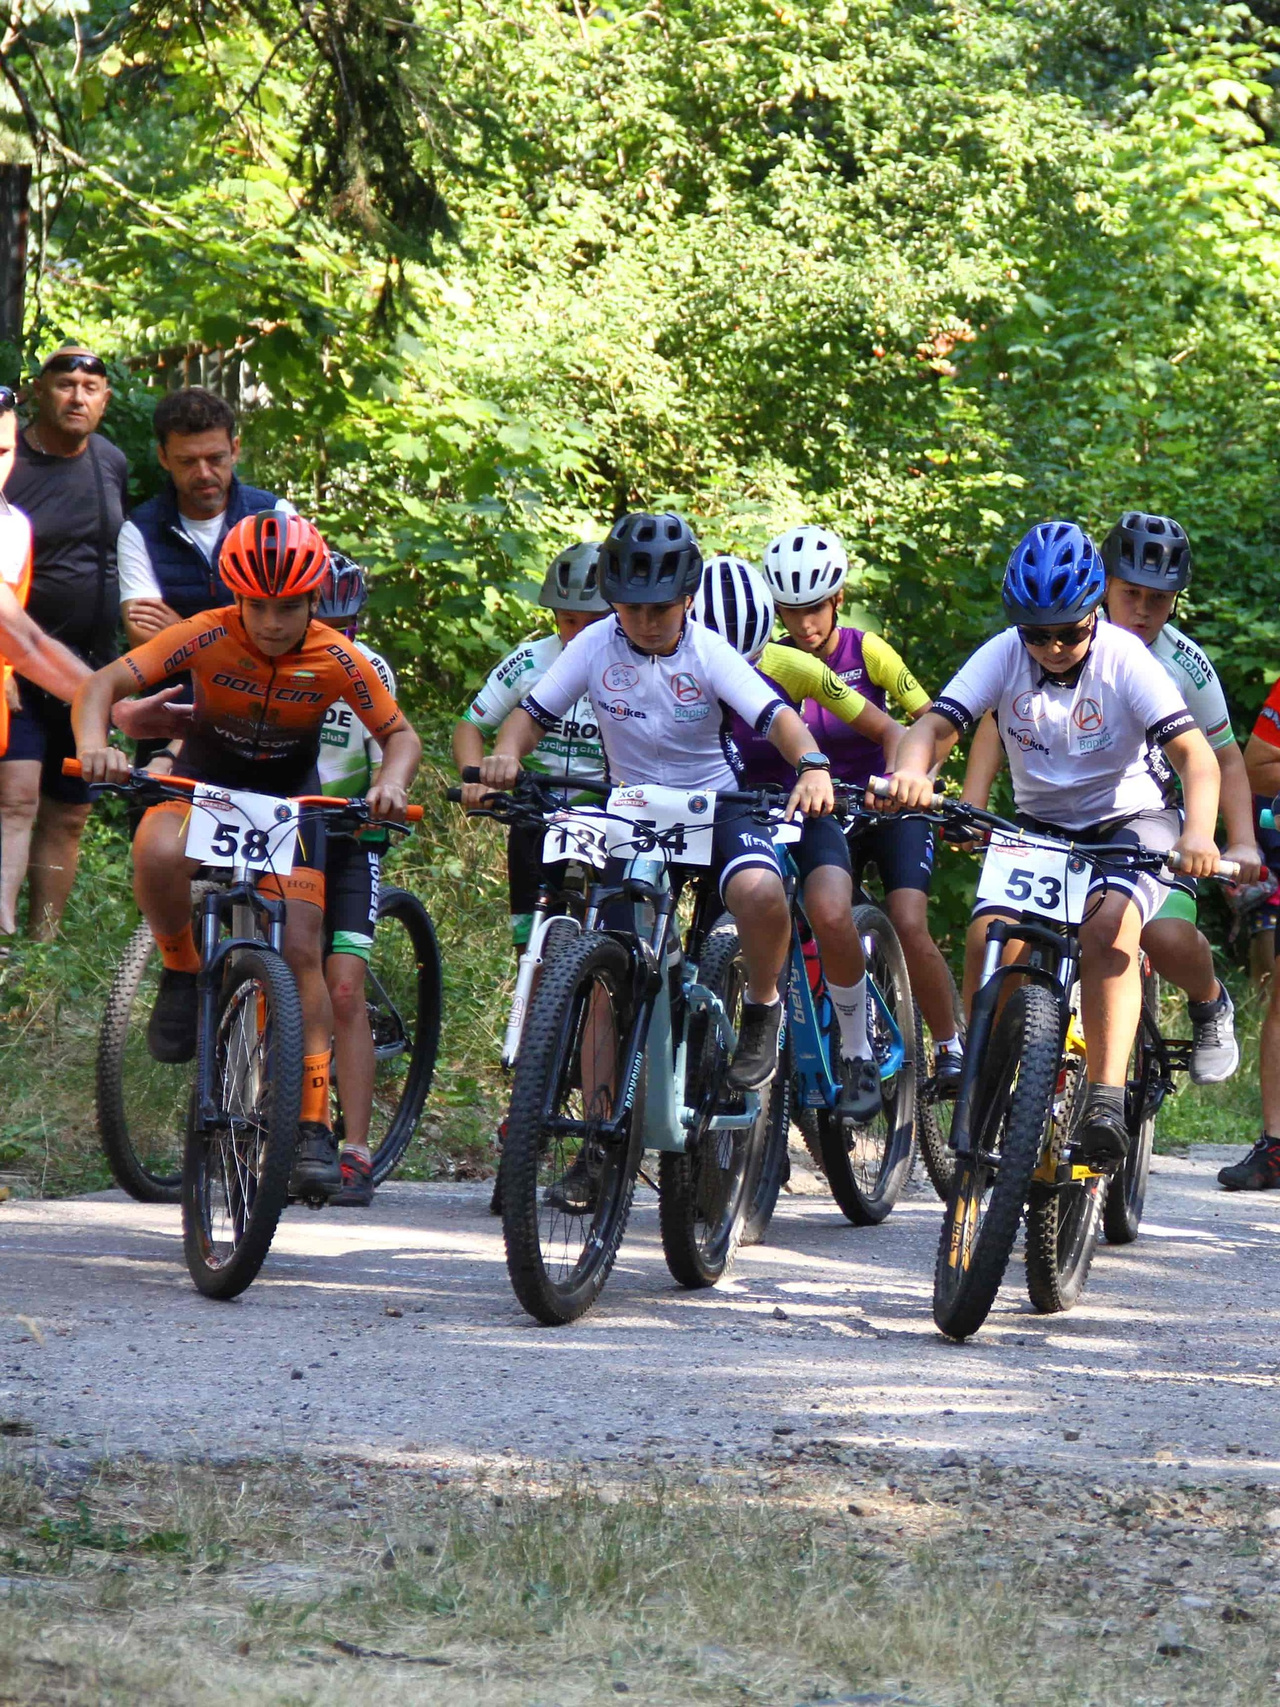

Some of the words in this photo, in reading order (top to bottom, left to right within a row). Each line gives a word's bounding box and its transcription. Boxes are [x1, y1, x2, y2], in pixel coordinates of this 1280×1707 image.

[325, 644, 374, 710] DOLTCINI
[496, 648, 534, 681] BEROE
[1176, 639, 1214, 682] BEROE
[1176, 655, 1204, 684] ROAD
[210, 823, 270, 862] 58
[632, 820, 687, 855] 54
[367, 851, 381, 924] BEROE
[1004, 868, 1062, 910] 53
